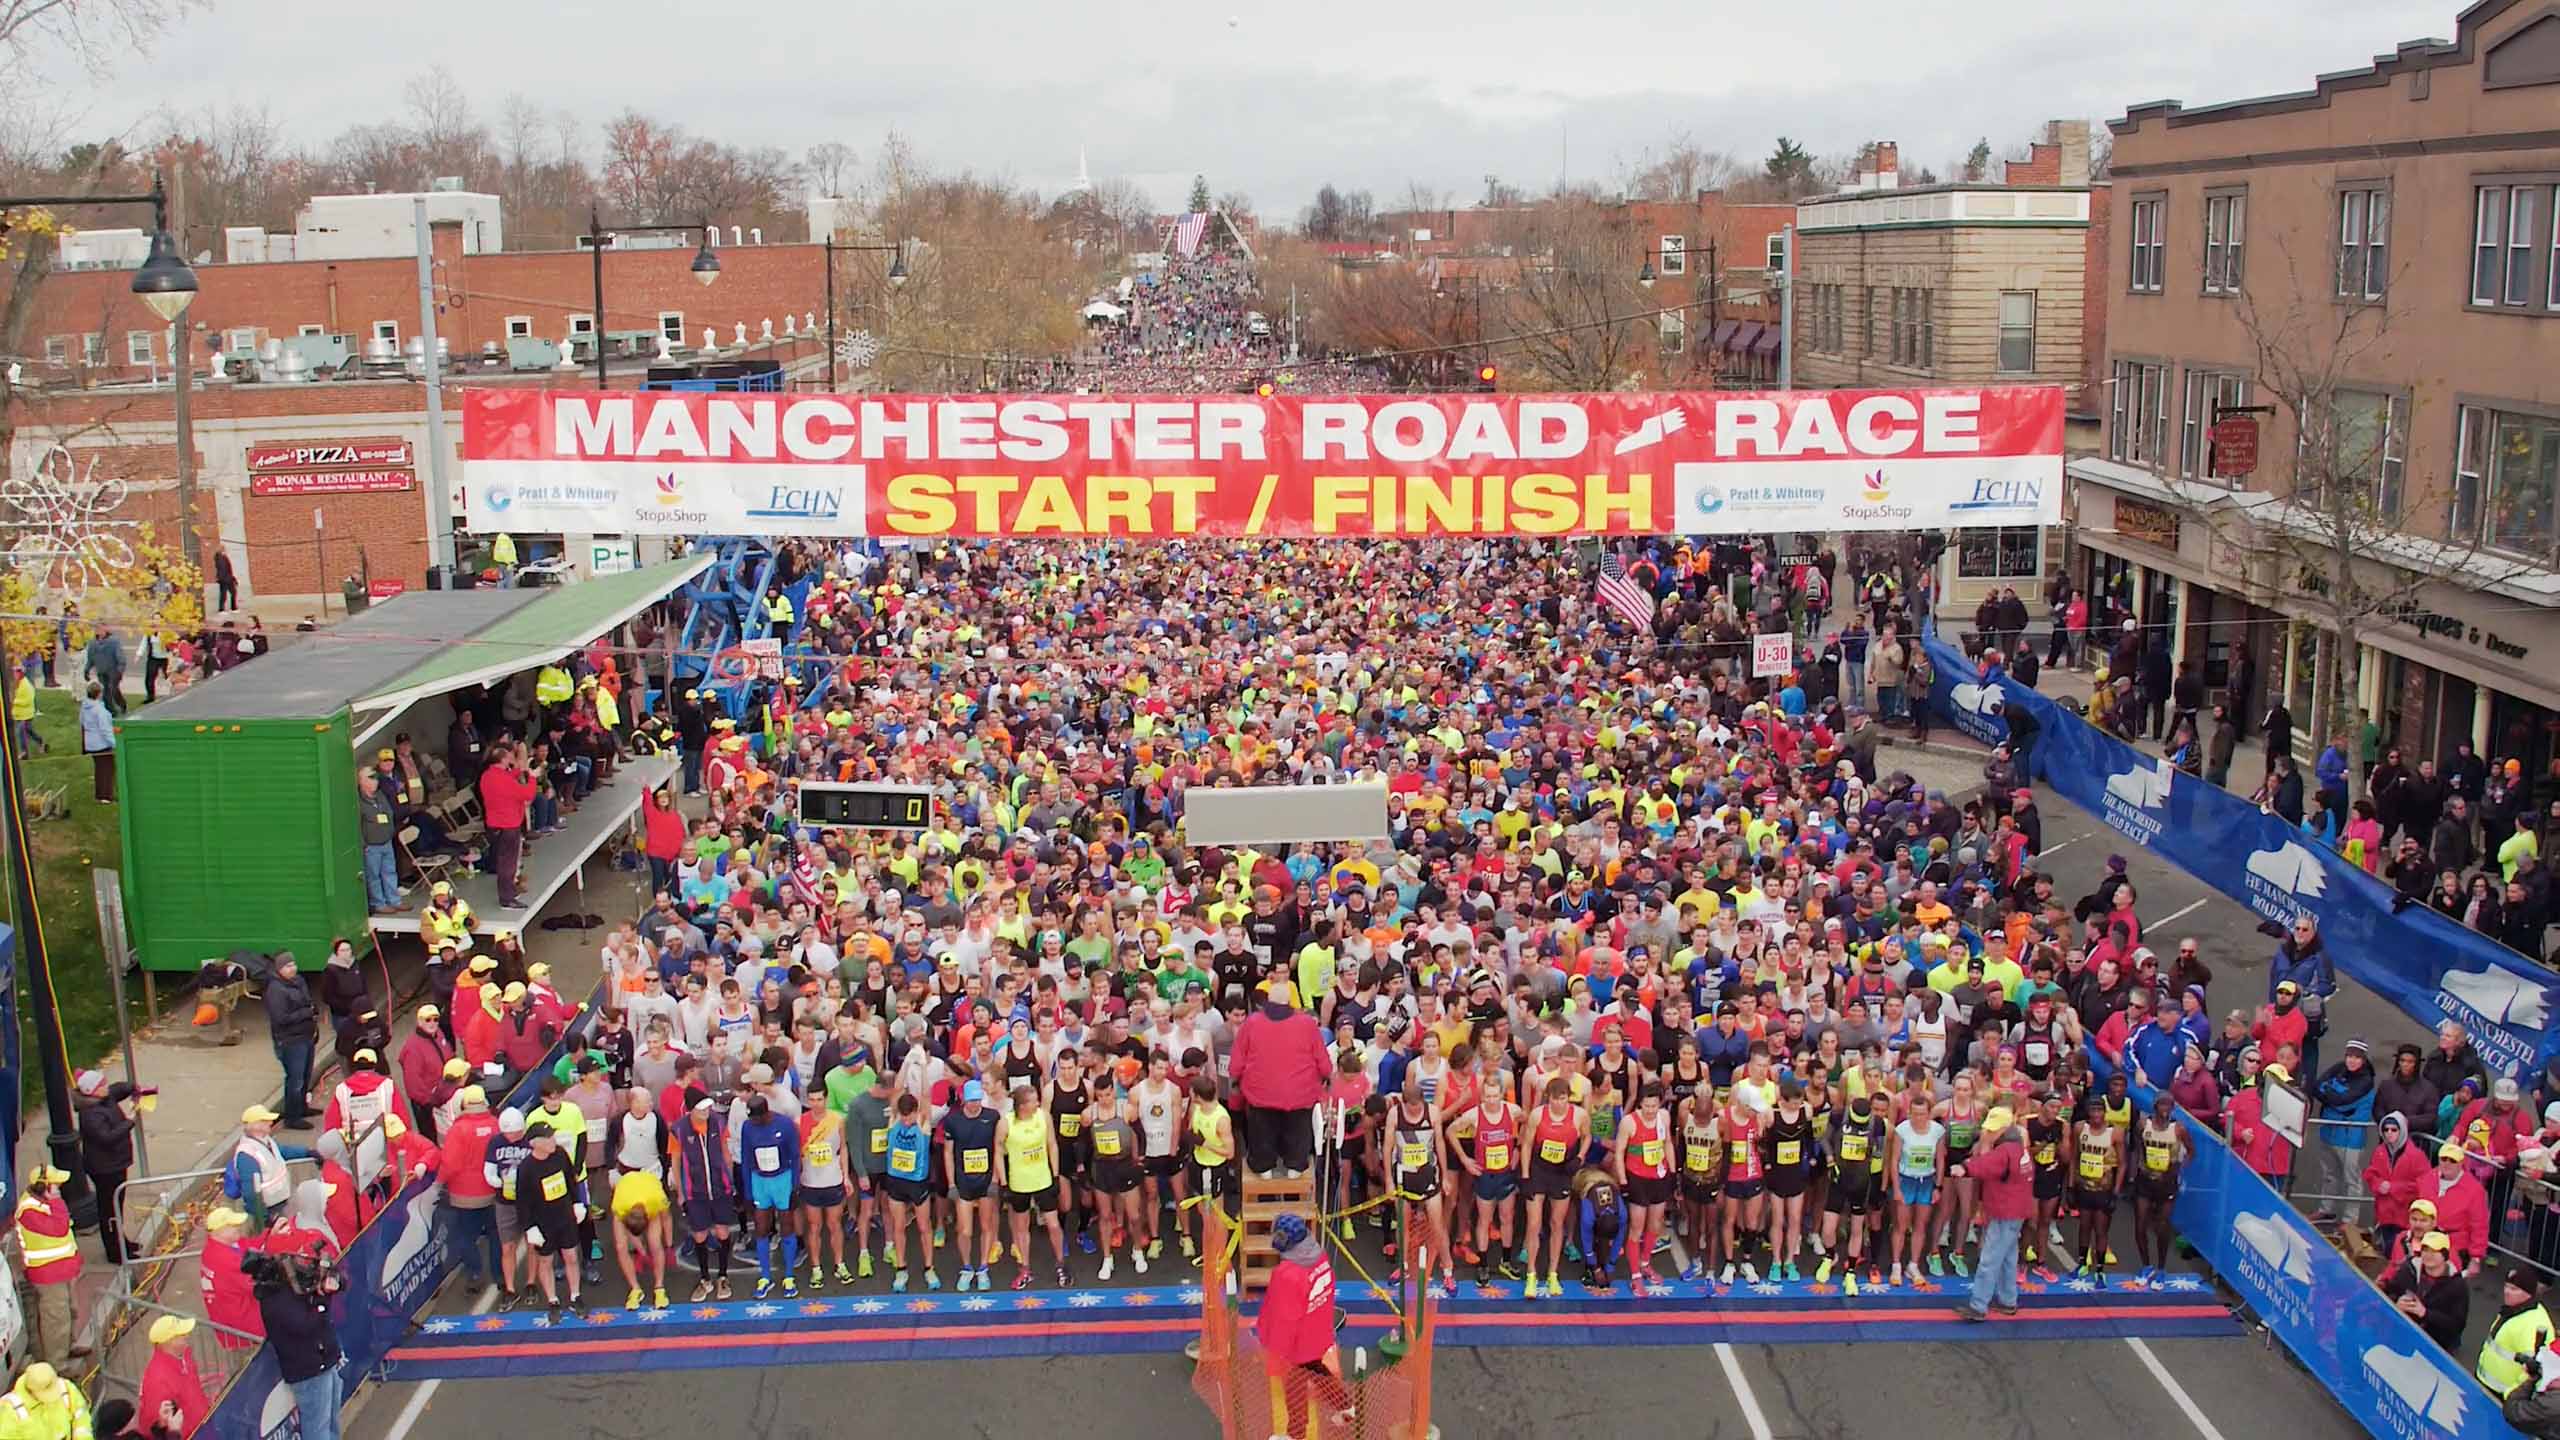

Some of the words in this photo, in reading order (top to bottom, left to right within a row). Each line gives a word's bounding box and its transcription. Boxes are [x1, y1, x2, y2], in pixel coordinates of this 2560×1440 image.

[554, 397, 1266, 462] MANCHESTER
[1302, 400, 1588, 461] ROAD
[1714, 395, 1981, 456] RACE
[296, 447, 360, 464] PIZZA
[317, 471, 390, 484] RESTAURANT
[1971, 478, 2042, 501] ECHN
[518, 486, 550, 500] Pratt
[552, 487, 562, 500] &
[564, 486, 619, 504] Whitney
[769, 486, 842, 513] ECHN
[887, 474, 1216, 534] START
[1313, 474, 1653, 533] FINISH
[1729, 487, 1760, 501] Pratt
[1763, 488, 1772, 500] &
[1775, 487, 1825, 504] Whitney
[635, 508, 707, 524] Stop&Shop
[1842, 504, 1912, 520] Stop&Shop
[595, 548, 610, 570] P
[1758, 646, 1788, 661] U-30
[2468, 627, 2480, 644] &
[2486, 631, 2528, 660] Decor
[1757, 663, 1788, 672] MINUTES
[906, 798, 923, 821] 0
[2116, 799, 2163, 836] MANCHESTER
[2104, 809, 2124, 831] ROAD
[2123, 820, 2143, 841] RACE
[2251, 893, 2276, 918] ROAD
[2434, 991, 2457, 1018] THE
[2473, 1041, 2508, 1072] RACE
[1687, 1137, 1715, 1148] ARMY
[2230, 1230, 2248, 1256] THE
[2237, 1257, 2266, 1292] ROAD
[2265, 1286, 2290, 1319] RACE
[2361, 1365, 2384, 1393] THE
[2376, 1397, 2406, 1438] ROAD
